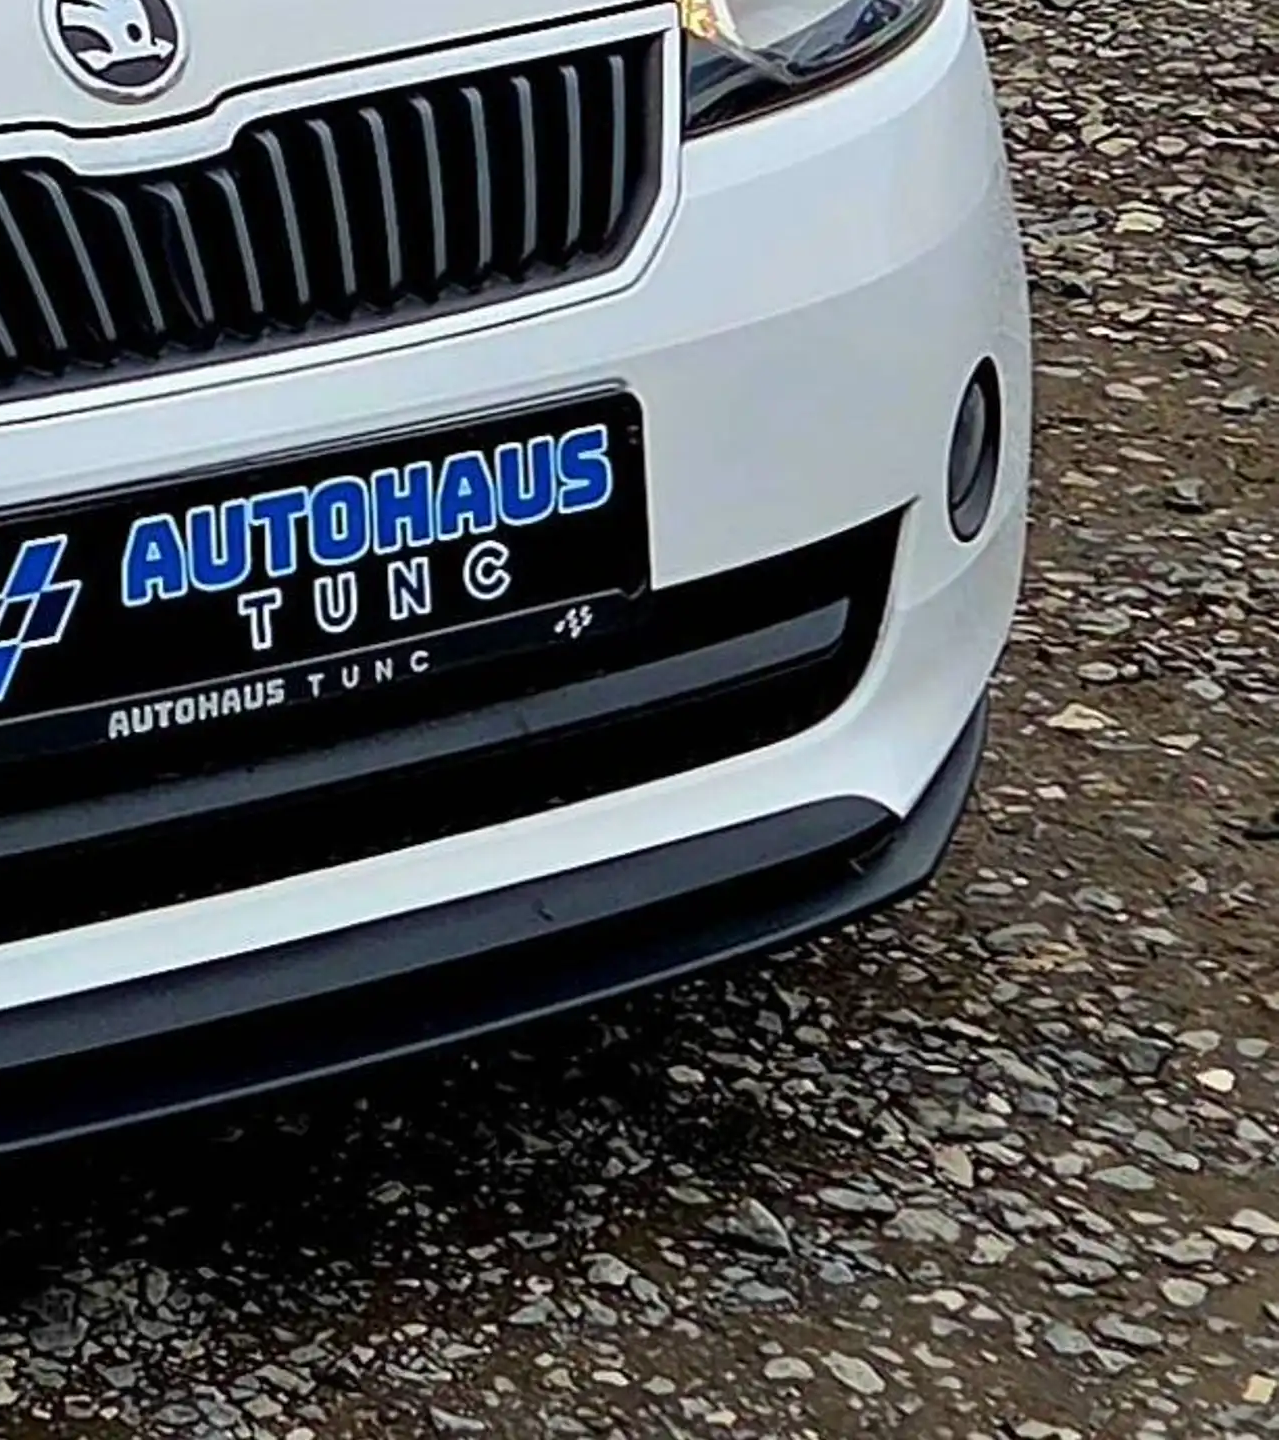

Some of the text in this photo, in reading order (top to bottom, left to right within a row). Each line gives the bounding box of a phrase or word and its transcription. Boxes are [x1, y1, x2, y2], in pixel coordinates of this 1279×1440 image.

[122, 424, 613, 606] AUTOHAUS
[239, 541, 511, 650] TUNC
[108, 651, 429, 739] AUTOHAUS TUNC
